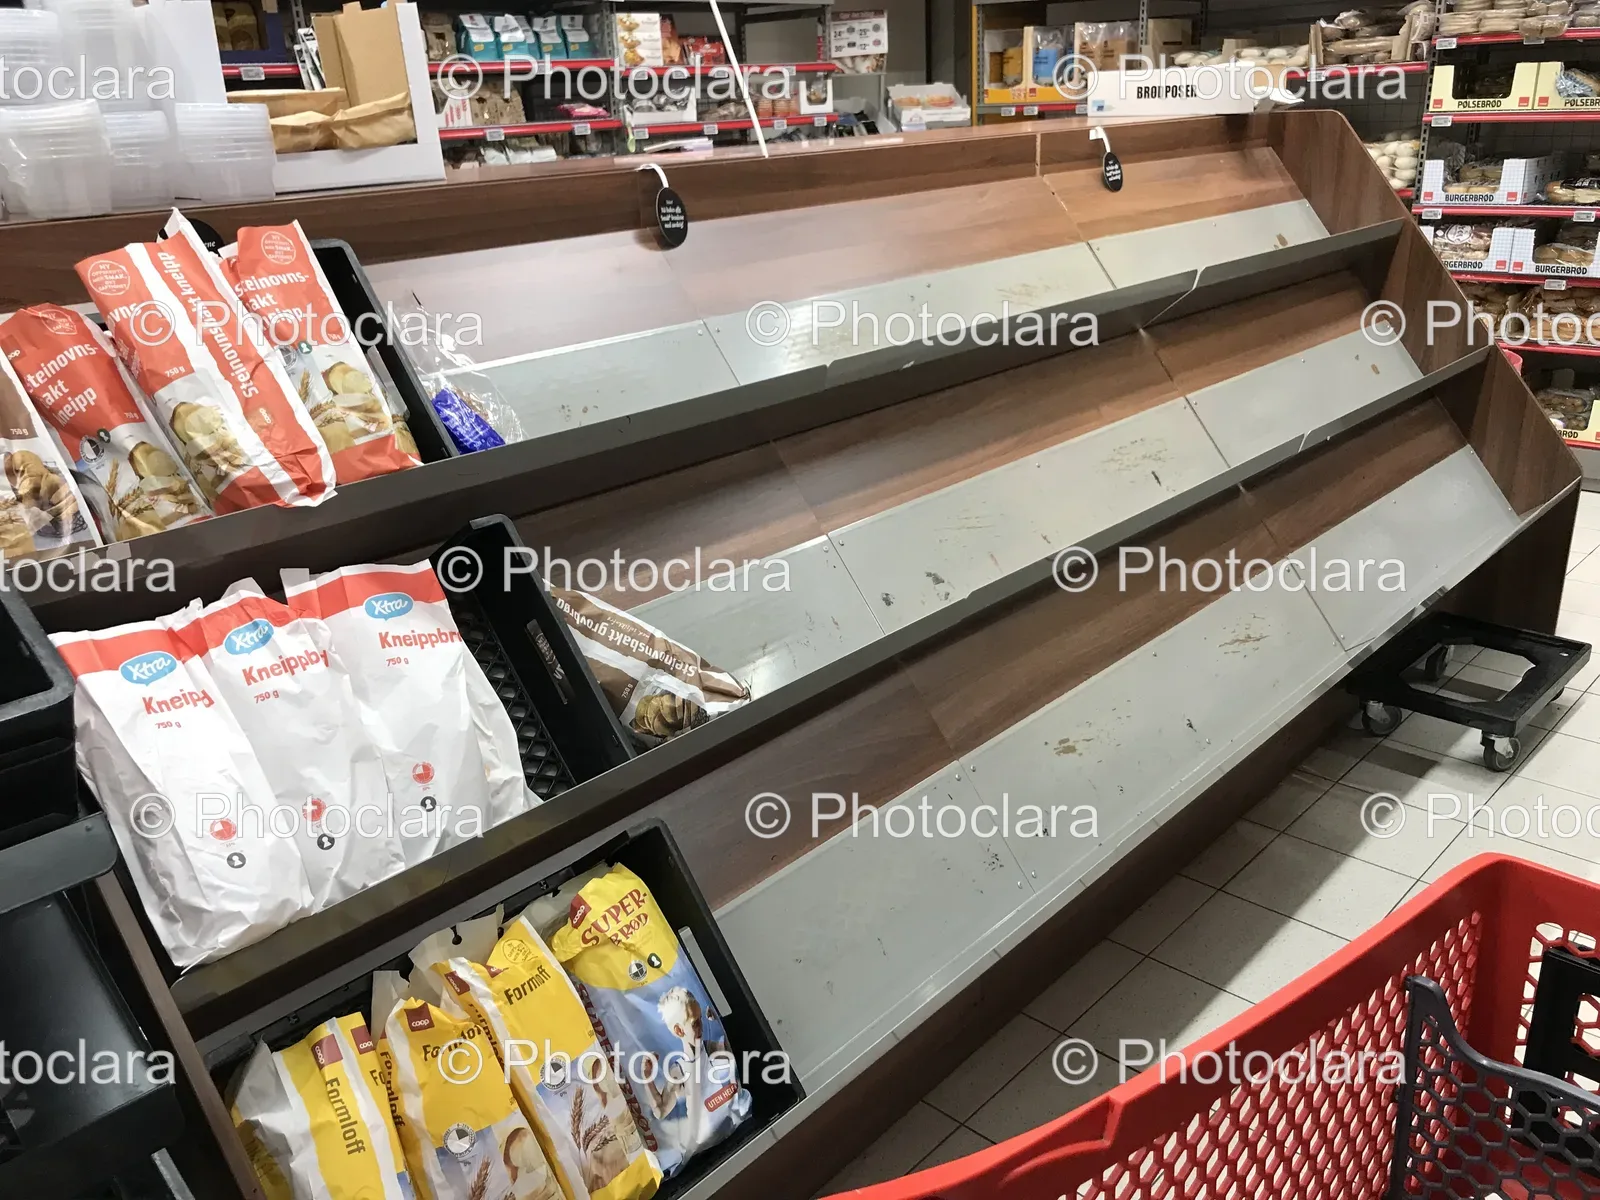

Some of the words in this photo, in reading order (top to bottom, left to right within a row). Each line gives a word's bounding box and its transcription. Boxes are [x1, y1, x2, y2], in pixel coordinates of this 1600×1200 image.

[1457, 99, 1502, 109] PØLSEBRØD
[1564, 98, 1600, 108] PØLSEBR
[1445, 194, 1494, 203] BURGERBRØD
[1442, 260, 1483, 269] RGERBRØD
[1535, 264, 1587, 275] BURGERBRØD
[157, 251, 197, 296] kneipp
[165, 367, 179, 378] 750
[10, 428, 23, 436] 750
[556, 597, 609, 637] grovbrød
[608, 627, 698, 678] Steinovnsbakt
[386, 656, 402, 667] 750
[253, 691, 271, 704] 750
[272, 689, 280, 699] g
[155, 720, 173, 730] 750
[174, 721, 182, 729] g
[572, 905, 586, 925] coop
[581, 888, 648, 946] SUPER-
[609, 912, 649, 946] BRØD
[411, 1018, 429, 1028] coop
[315, 1045, 325, 1065] coop
[707, 1094, 723, 1109] UTEN
[325, 1076, 366, 1156] Formloff
